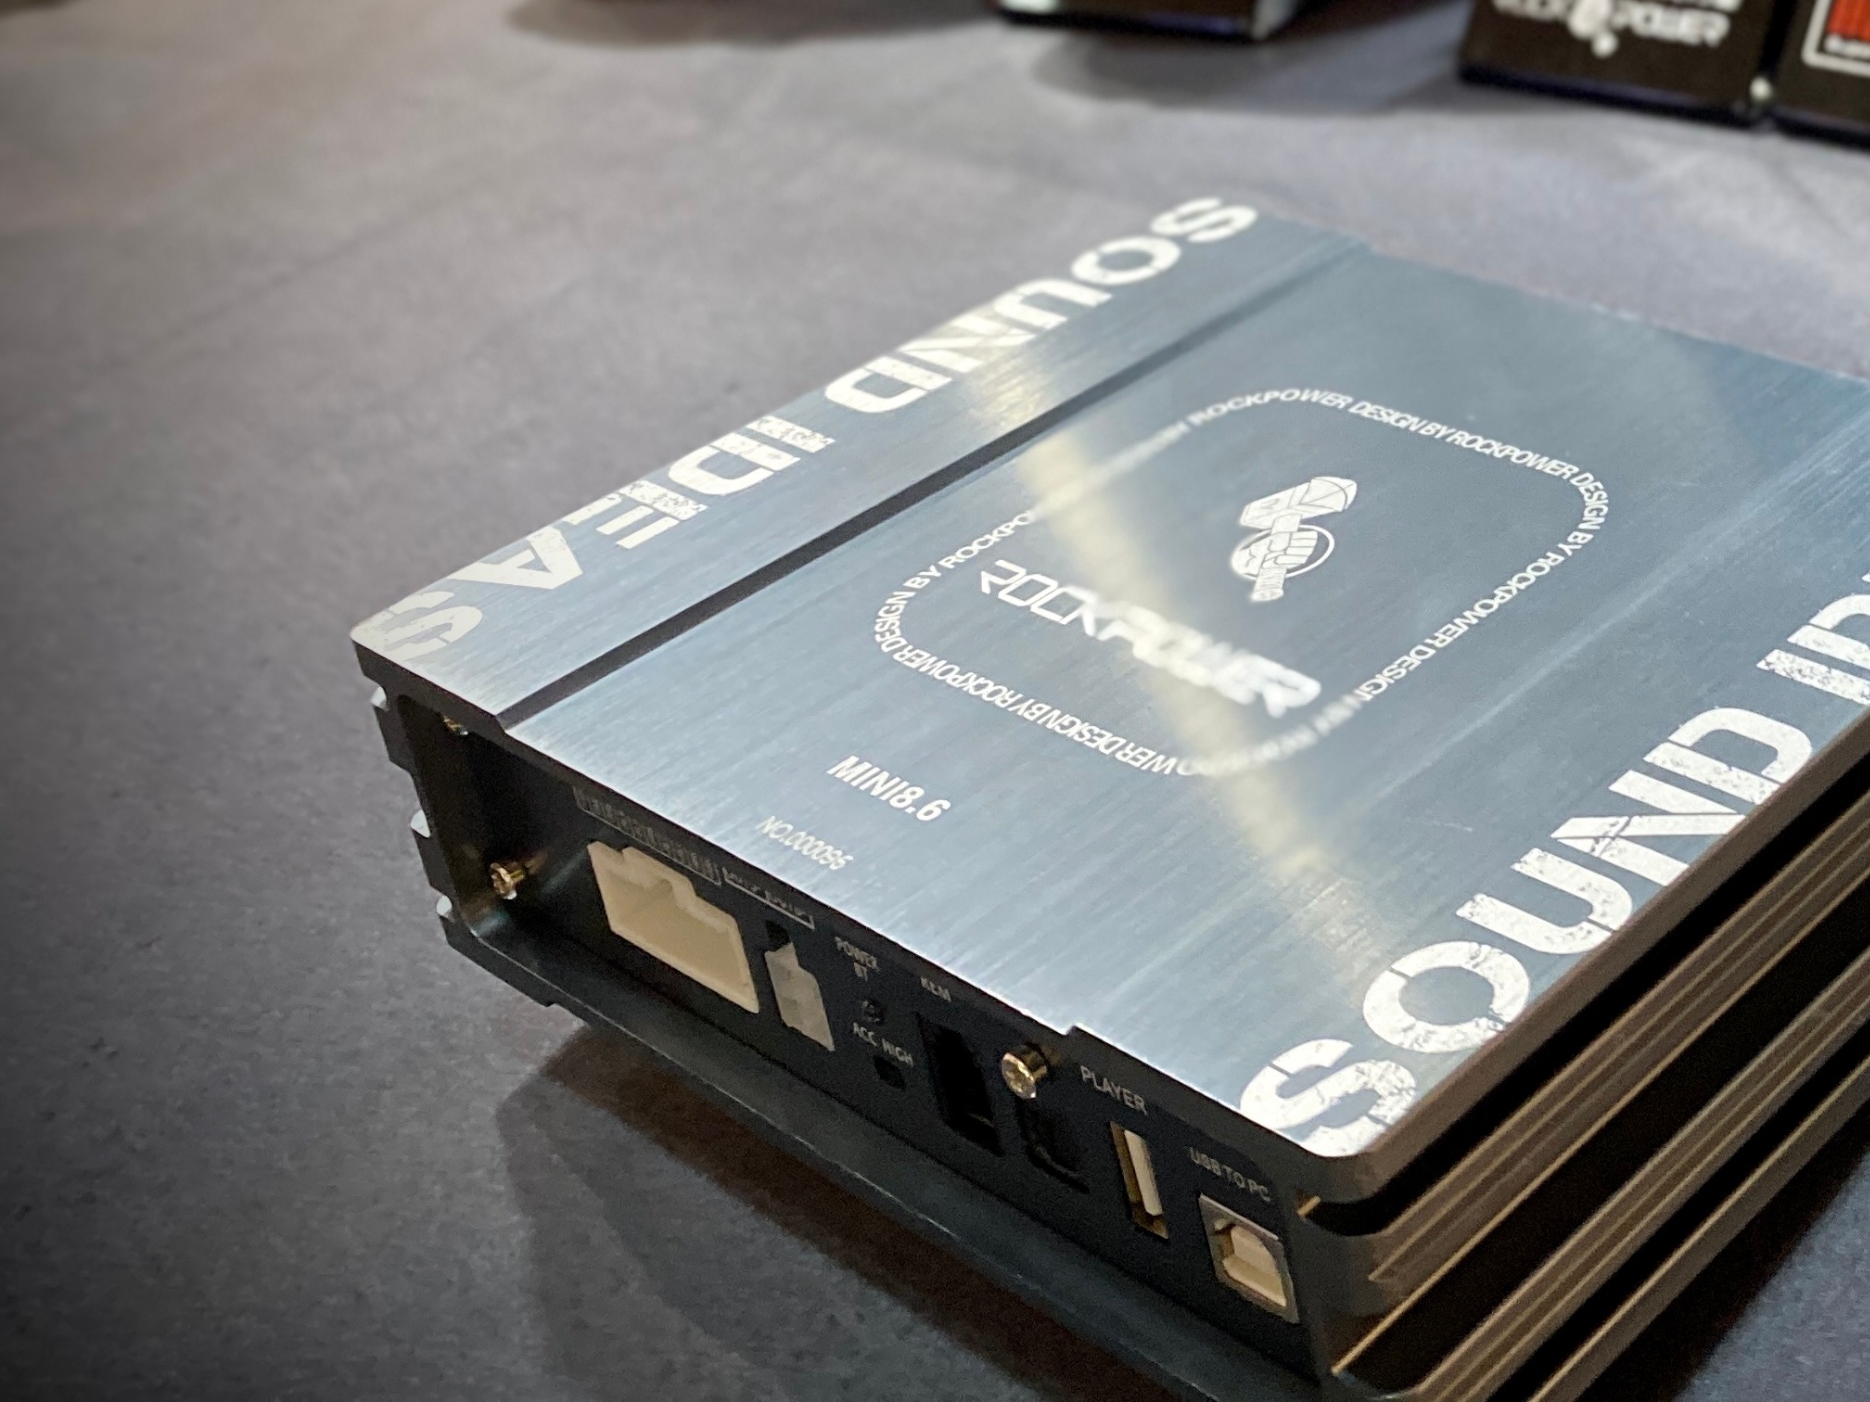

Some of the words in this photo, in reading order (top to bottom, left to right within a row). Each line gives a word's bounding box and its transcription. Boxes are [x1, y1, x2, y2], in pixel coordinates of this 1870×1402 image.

[824, 197, 1258, 413] SOUND
[1187, 388, 1354, 427] ROCKPOWER
[1349, 401, 1428, 432] DESIGN
[1420, 422, 1455, 439] BY
[1446, 430, 1580, 481] ROCKPOWER
[1569, 472, 1609, 530] DESIGN
[354, 415, 836, 662] IDEAS
[1558, 531, 1594, 556] BY
[903, 565, 942, 589] BY
[1425, 551, 1565, 649] ROCKPOWER
[874, 591, 916, 653] DESIGN
[892, 645, 1024, 709] ROCKPOWER
[1345, 644, 1437, 708] DESIGN
[1037, 710, 1127, 756] DESIGN
[827, 755, 951, 822] MINI8.6
[1240, 706, 1814, 1157] SOUND
[1080, 1065, 1148, 1116] PLAYER
[1189, 1147, 1221, 1176] USB
[1221, 1164, 1246, 1189] TO
[1247, 1178, 1271, 1202] PC
